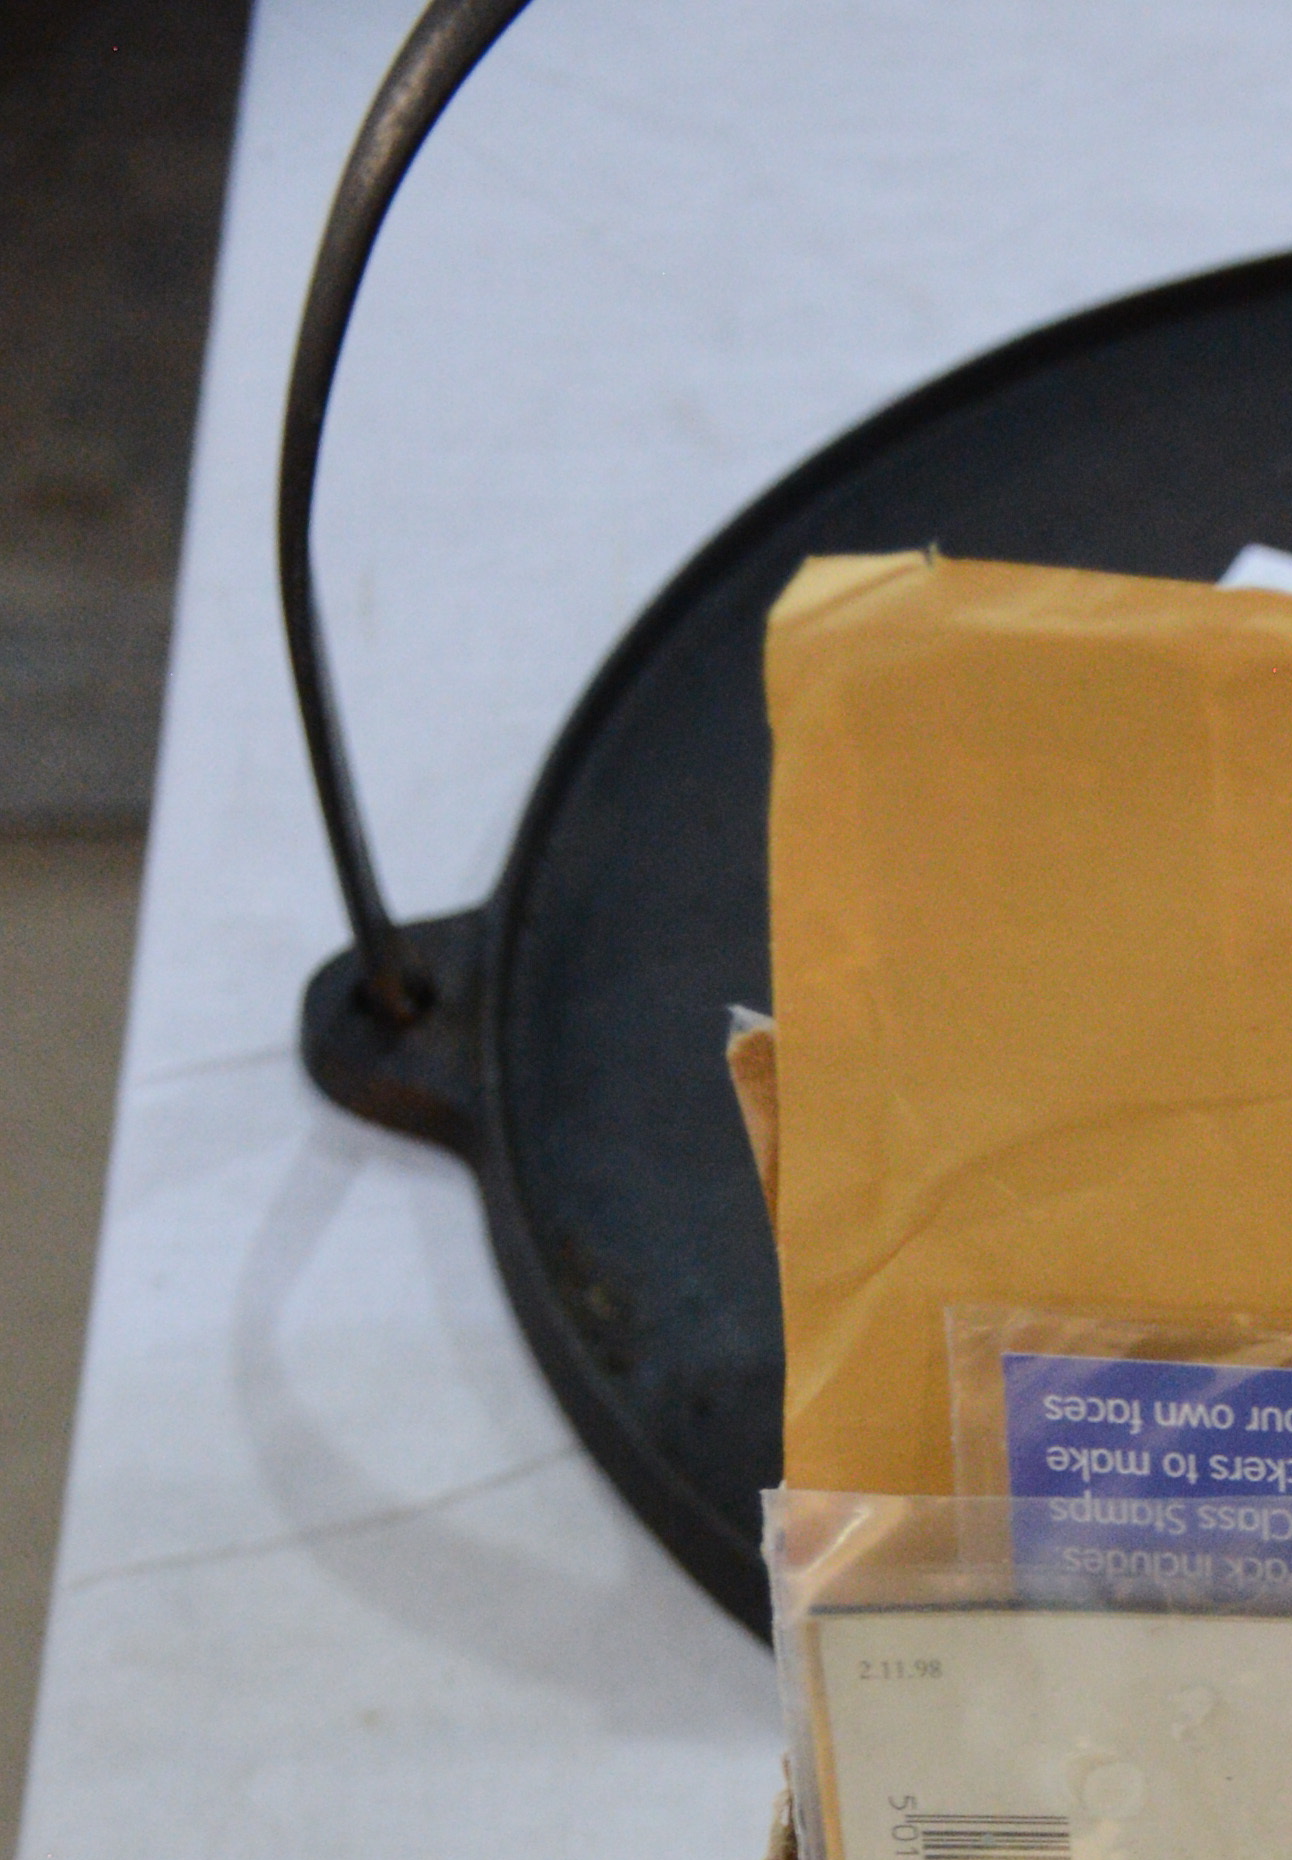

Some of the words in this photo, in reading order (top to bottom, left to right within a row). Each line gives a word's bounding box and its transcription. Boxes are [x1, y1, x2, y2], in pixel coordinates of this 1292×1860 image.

[1045, 1393, 1143, 1435] faces
[1153, 1402, 1236, 1431] own
[1046, 1445, 1152, 1483] make
[1162, 1451, 1199, 1485] to
[1049, 1490, 1188, 1535] Stamps
